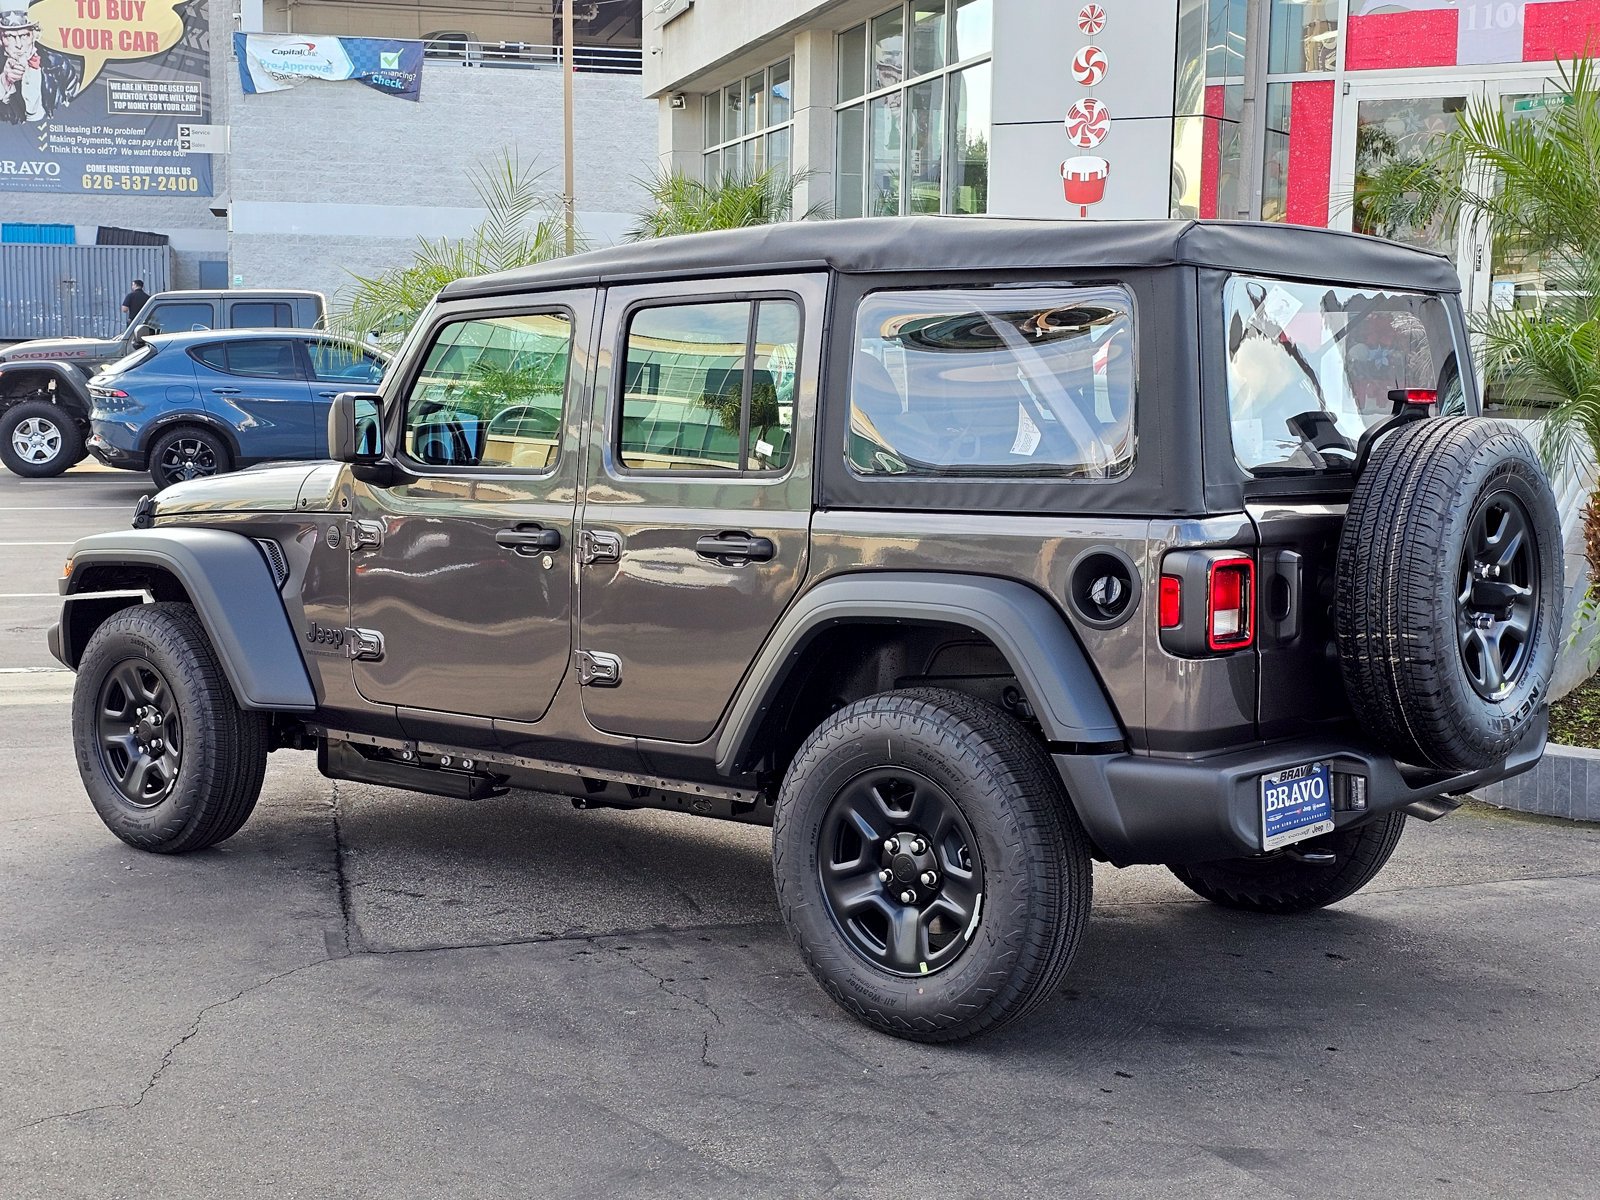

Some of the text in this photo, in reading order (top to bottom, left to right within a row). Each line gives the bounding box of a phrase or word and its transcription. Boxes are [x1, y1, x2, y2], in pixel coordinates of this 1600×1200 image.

[75, 0, 146, 21] TO BUY
[60, 28, 159, 52] YOUR CAR
[110, 82, 121, 90] WE
[122, 82, 134, 90] ARE
[143, 83, 158, 91] NEED
[372, 74, 404, 90] Check.
[128, 102, 149, 110] MONEY
[163, 103, 181, 111] YOUR
[181, 104, 196, 112] CAR!
[65, 125, 90, 135] leasing
[114, 127, 146, 136] problem!
[50, 135, 75, 144] Making
[77, 136, 114, 145] Payments,
[97, 147, 118, 155] old??
[86, 164, 106, 172] COME
[107, 165, 130, 173] INSIDE
[131, 165, 153, 174] TODAY
[182, 167, 191, 175] US
[82, 174, 198, 192] 626-537-2400
[12, 350, 88, 360] MOJAVE
[306, 622, 344, 650] Jeep
[1280, 764, 1312, 781] BRAVO
[1266, 778, 1324, 812] BRAVO
[1312, 824, 1324, 834] Jeep
